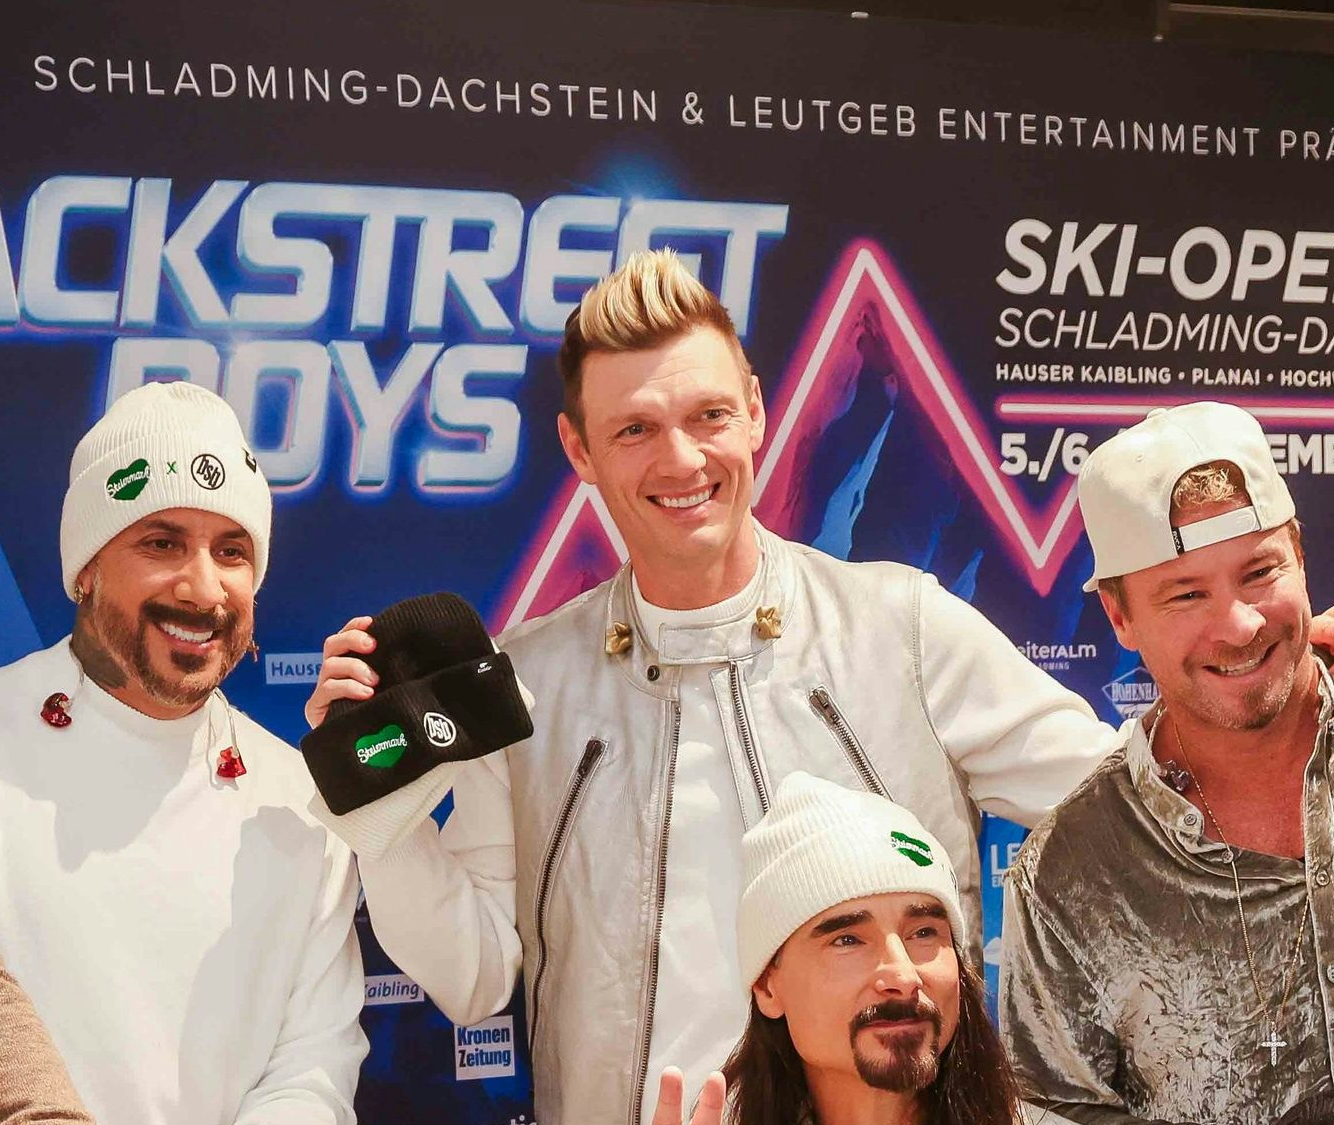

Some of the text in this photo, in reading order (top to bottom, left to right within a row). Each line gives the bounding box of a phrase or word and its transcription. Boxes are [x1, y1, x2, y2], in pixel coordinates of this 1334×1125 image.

[33, 55, 657, 122] SCHLADMING-DACHSTEIN
[681, 91, 704, 125] &
[729, 94, 915, 137] LEUTGEB
[938, 108, 1259, 158] ENTERTAINMENT
[996, 363, 1074, 382] HAUSER
[1081, 365, 1171, 385] KAIBLING
[1192, 367, 1261, 386] PLANAI
[1000, 428, 1090, 481] 5./6
[271, 661, 320, 677] HAUSE
[357, 733, 407, 764] Steiermark
[365, 981, 419, 999] aibling
[457, 1026, 510, 1046] Kronen
[458, 1047, 511, 1068] Zeitung
